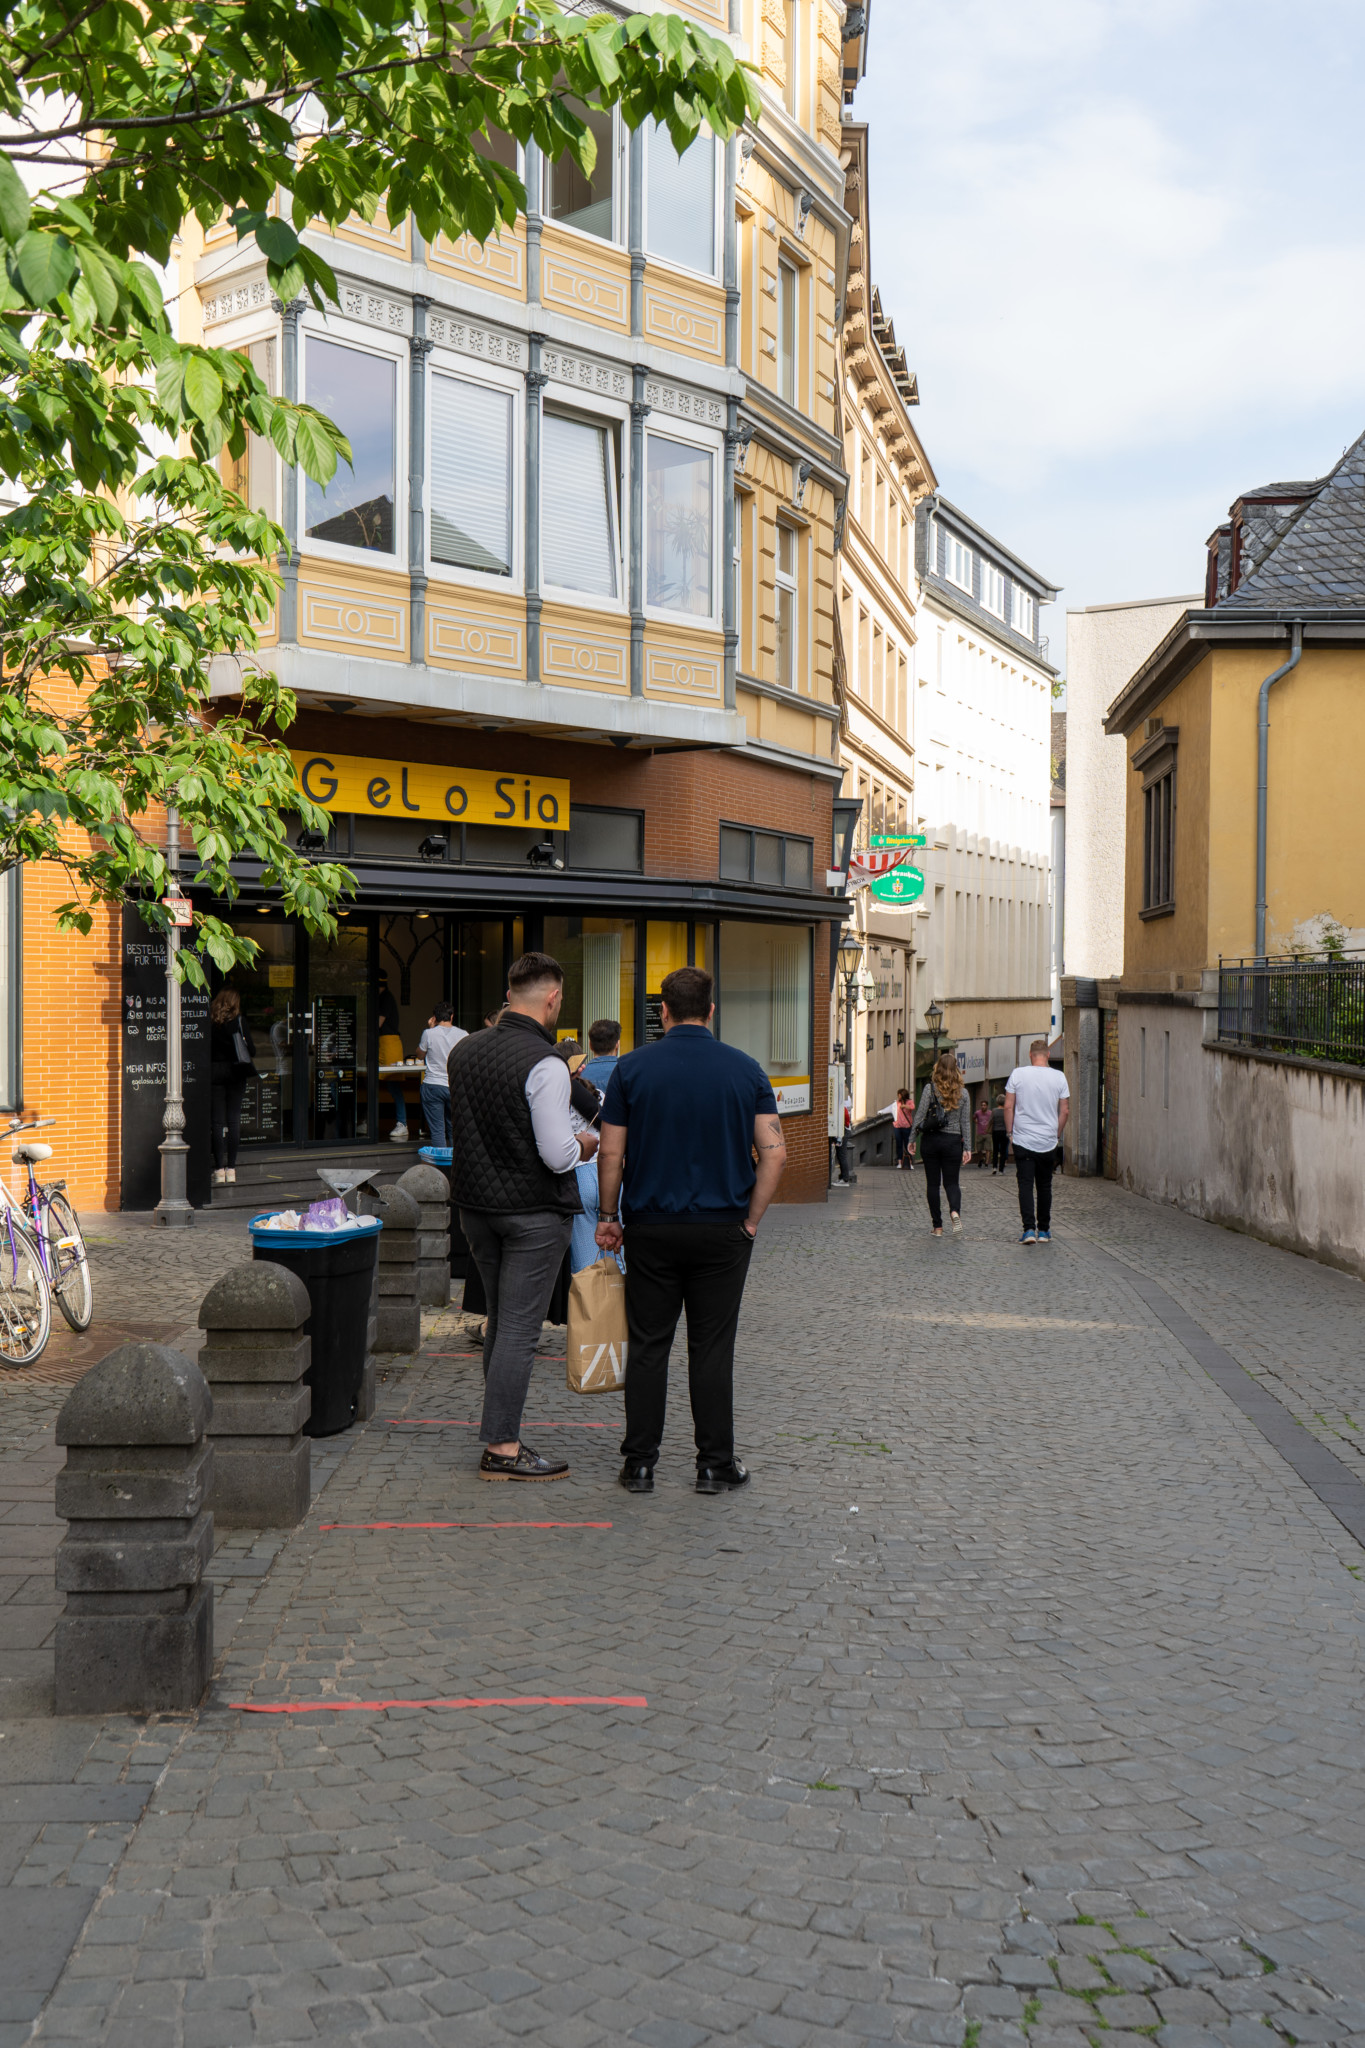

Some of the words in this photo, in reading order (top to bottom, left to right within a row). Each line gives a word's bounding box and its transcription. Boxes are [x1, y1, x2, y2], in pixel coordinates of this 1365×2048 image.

[134, 955, 149, 966] FÜR
[126, 1064, 144, 1074] MEHR
[145, 1062, 167, 1073] INFOS
